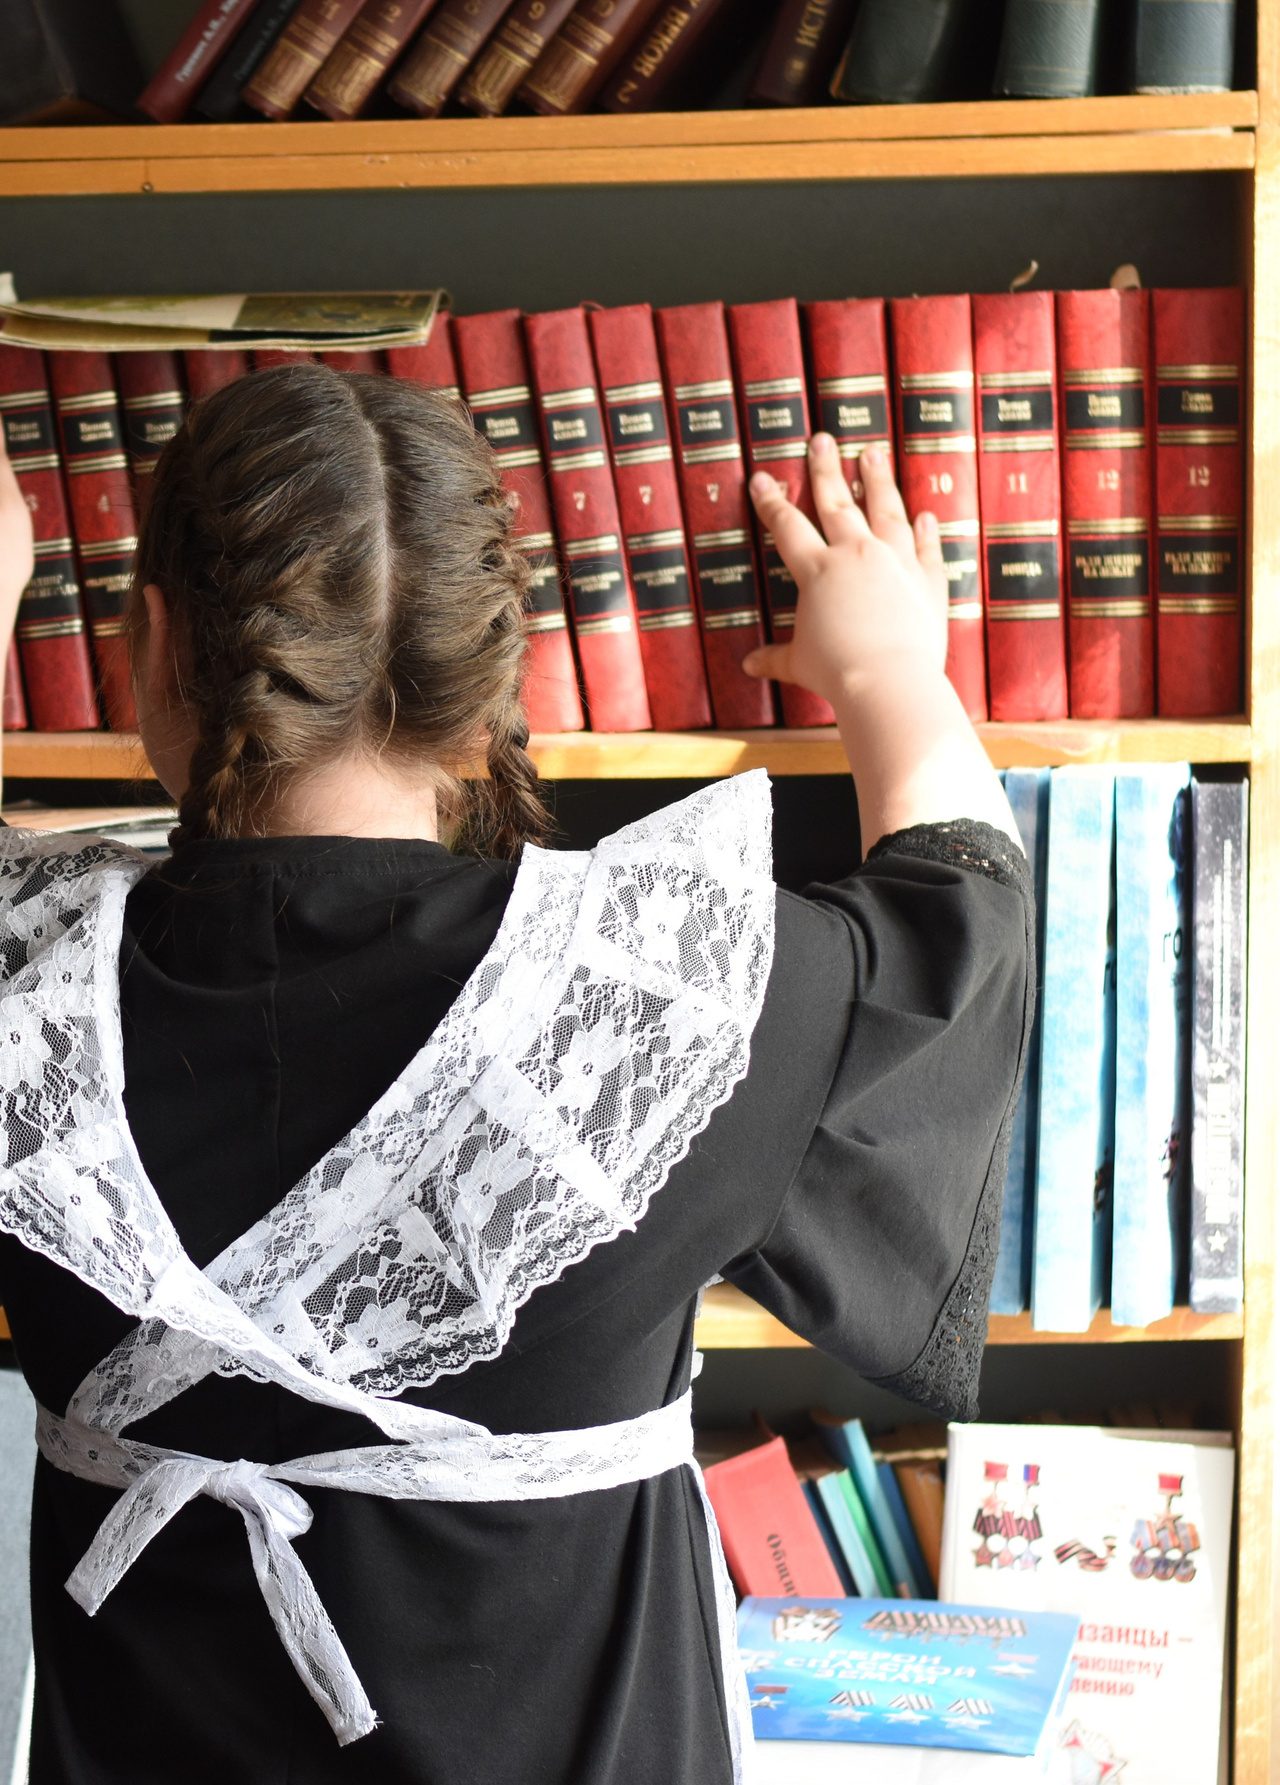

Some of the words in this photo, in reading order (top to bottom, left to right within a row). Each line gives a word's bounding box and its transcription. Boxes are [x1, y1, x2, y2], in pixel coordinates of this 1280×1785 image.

[929, 473, 953, 495] 10
[1006, 473, 1029, 494] 11
[1097, 468, 1120, 490] 12
[1188, 465, 1210, 487] 12
[97, 493, 110, 513] 4
[573, 491, 586, 511] 7
[638, 485, 652, 505] 7
[706, 482, 721, 503] 7
[811, 1666, 939, 1685] ЗЕМЛИ
